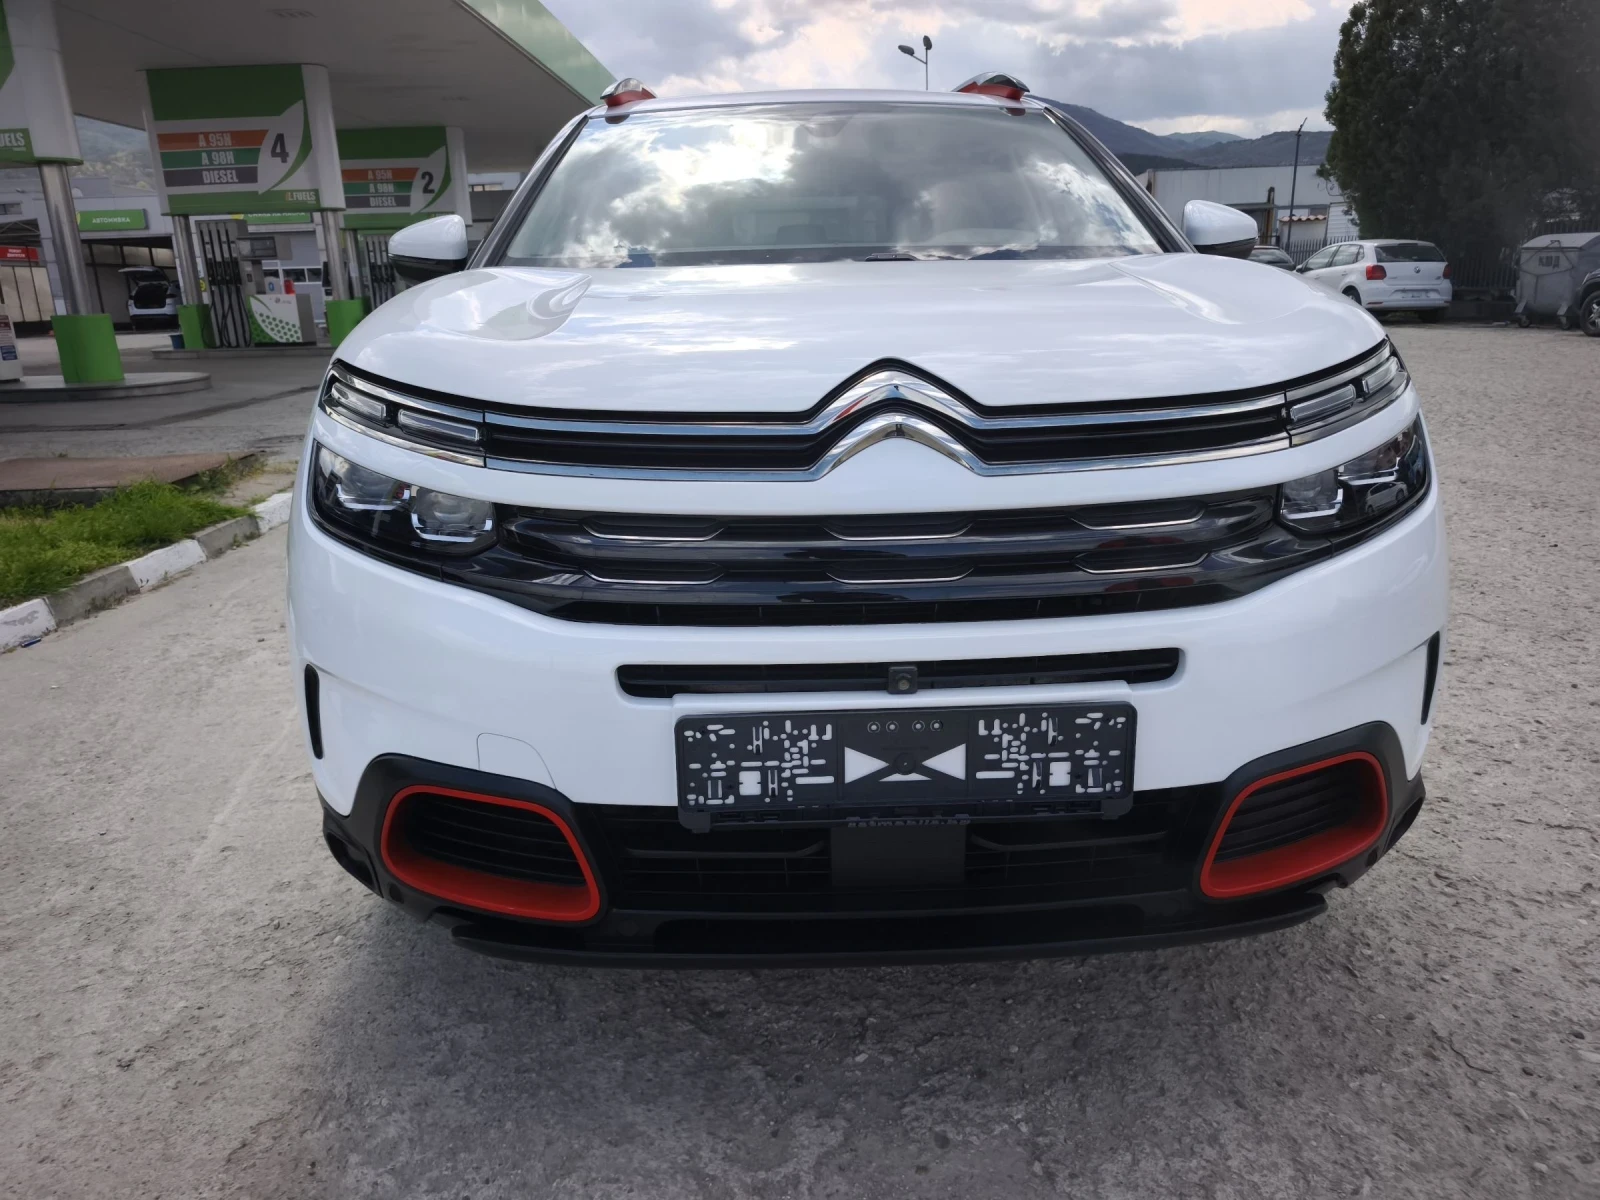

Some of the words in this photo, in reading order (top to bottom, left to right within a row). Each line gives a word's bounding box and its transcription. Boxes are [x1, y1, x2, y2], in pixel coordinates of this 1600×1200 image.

[198, 134, 206, 147] A
[208, 133, 232, 146] 95H
[270, 133, 289, 163] 4
[201, 152, 209, 165] A
[211, 151, 235, 164] 98H
[202, 169, 239, 184] DIESEL
[421, 171, 435, 194] 2
[369, 196, 397, 207] DIESEL
